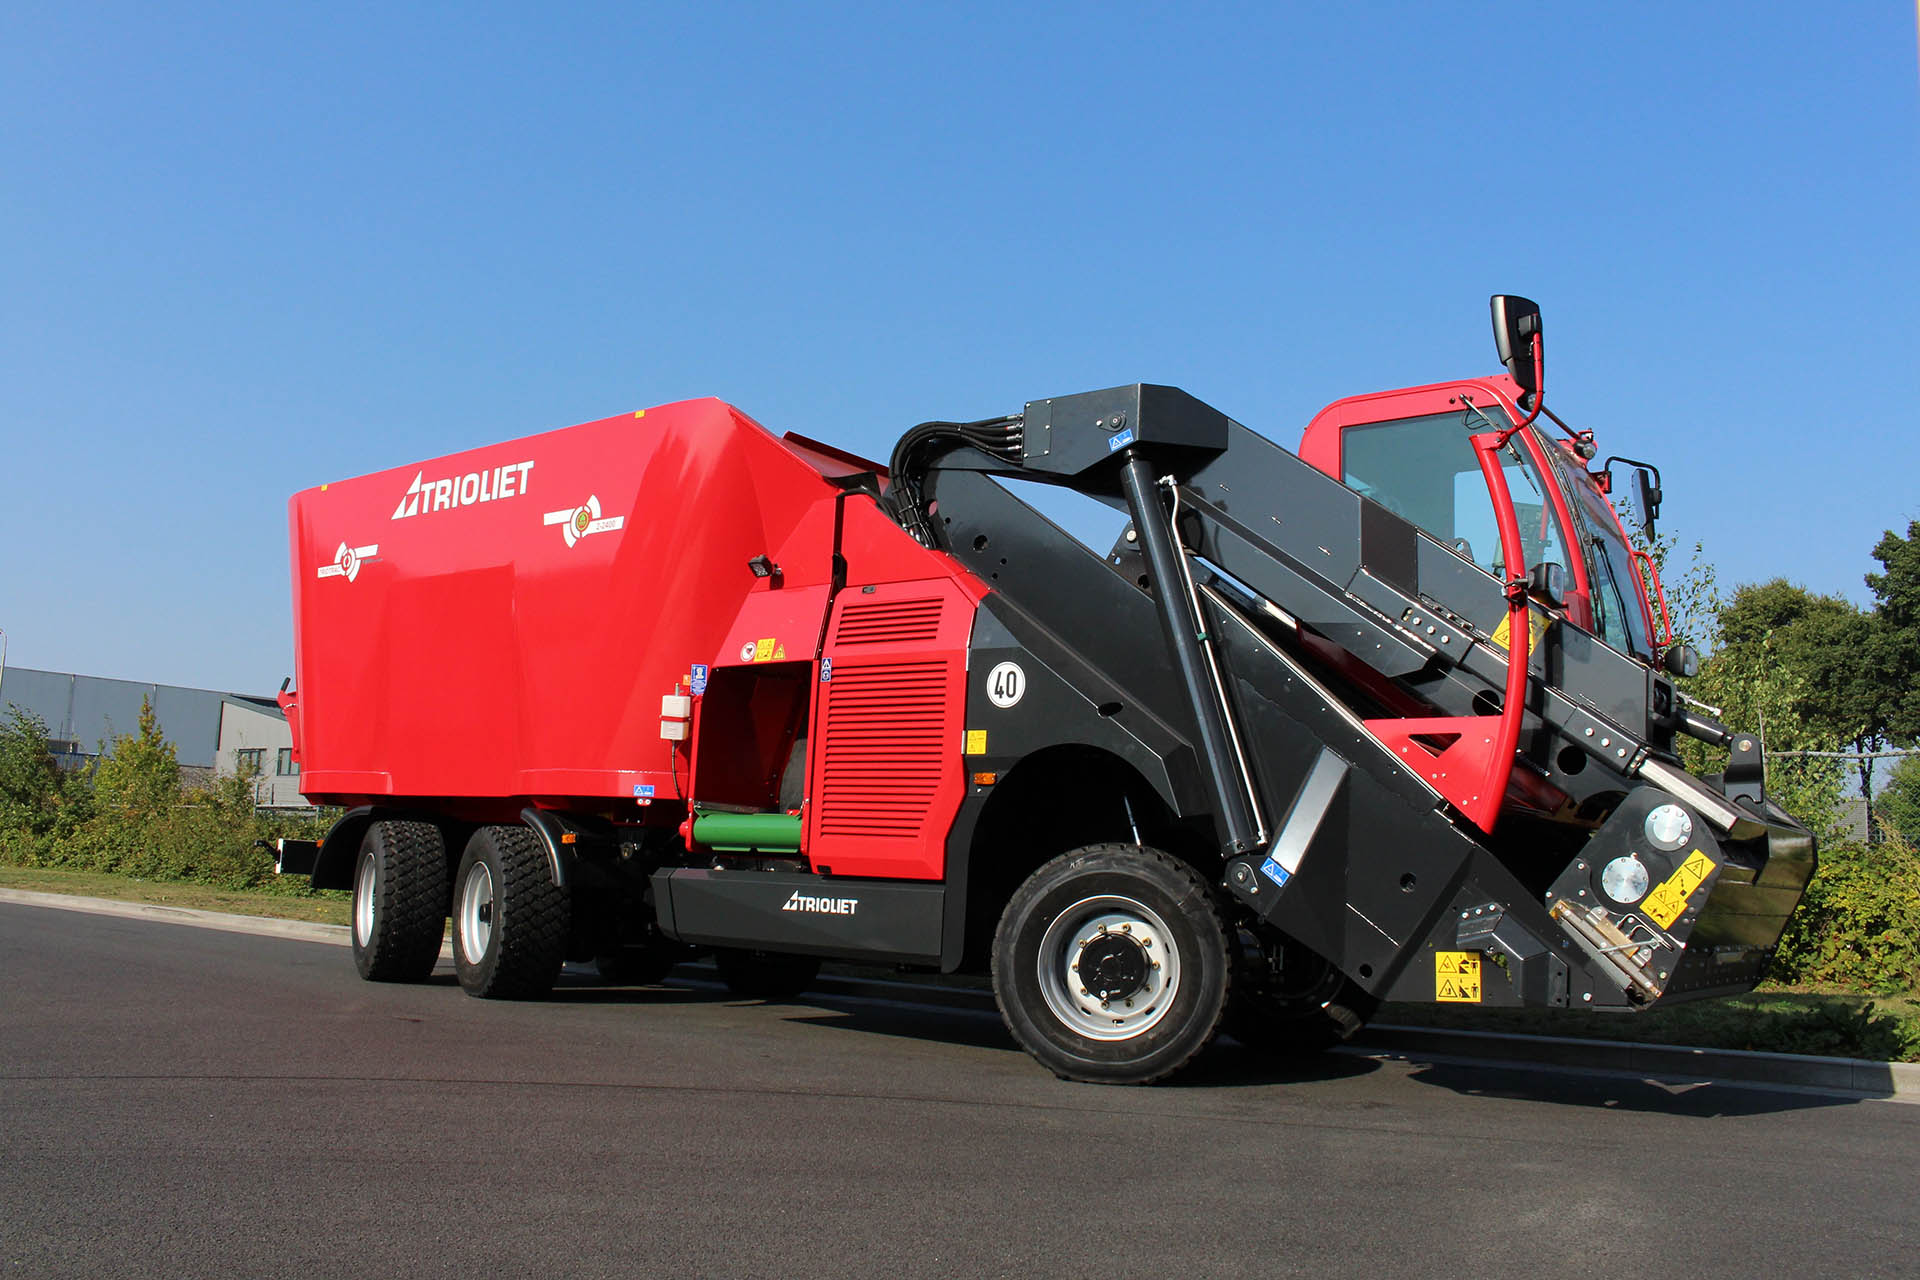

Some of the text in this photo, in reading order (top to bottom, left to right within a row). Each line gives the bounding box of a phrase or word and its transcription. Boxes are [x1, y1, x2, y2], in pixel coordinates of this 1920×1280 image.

[420, 460, 534, 514] TRIOLIET
[994, 670, 1017, 699] 40
[798, 896, 858, 915] TRIOLIET
